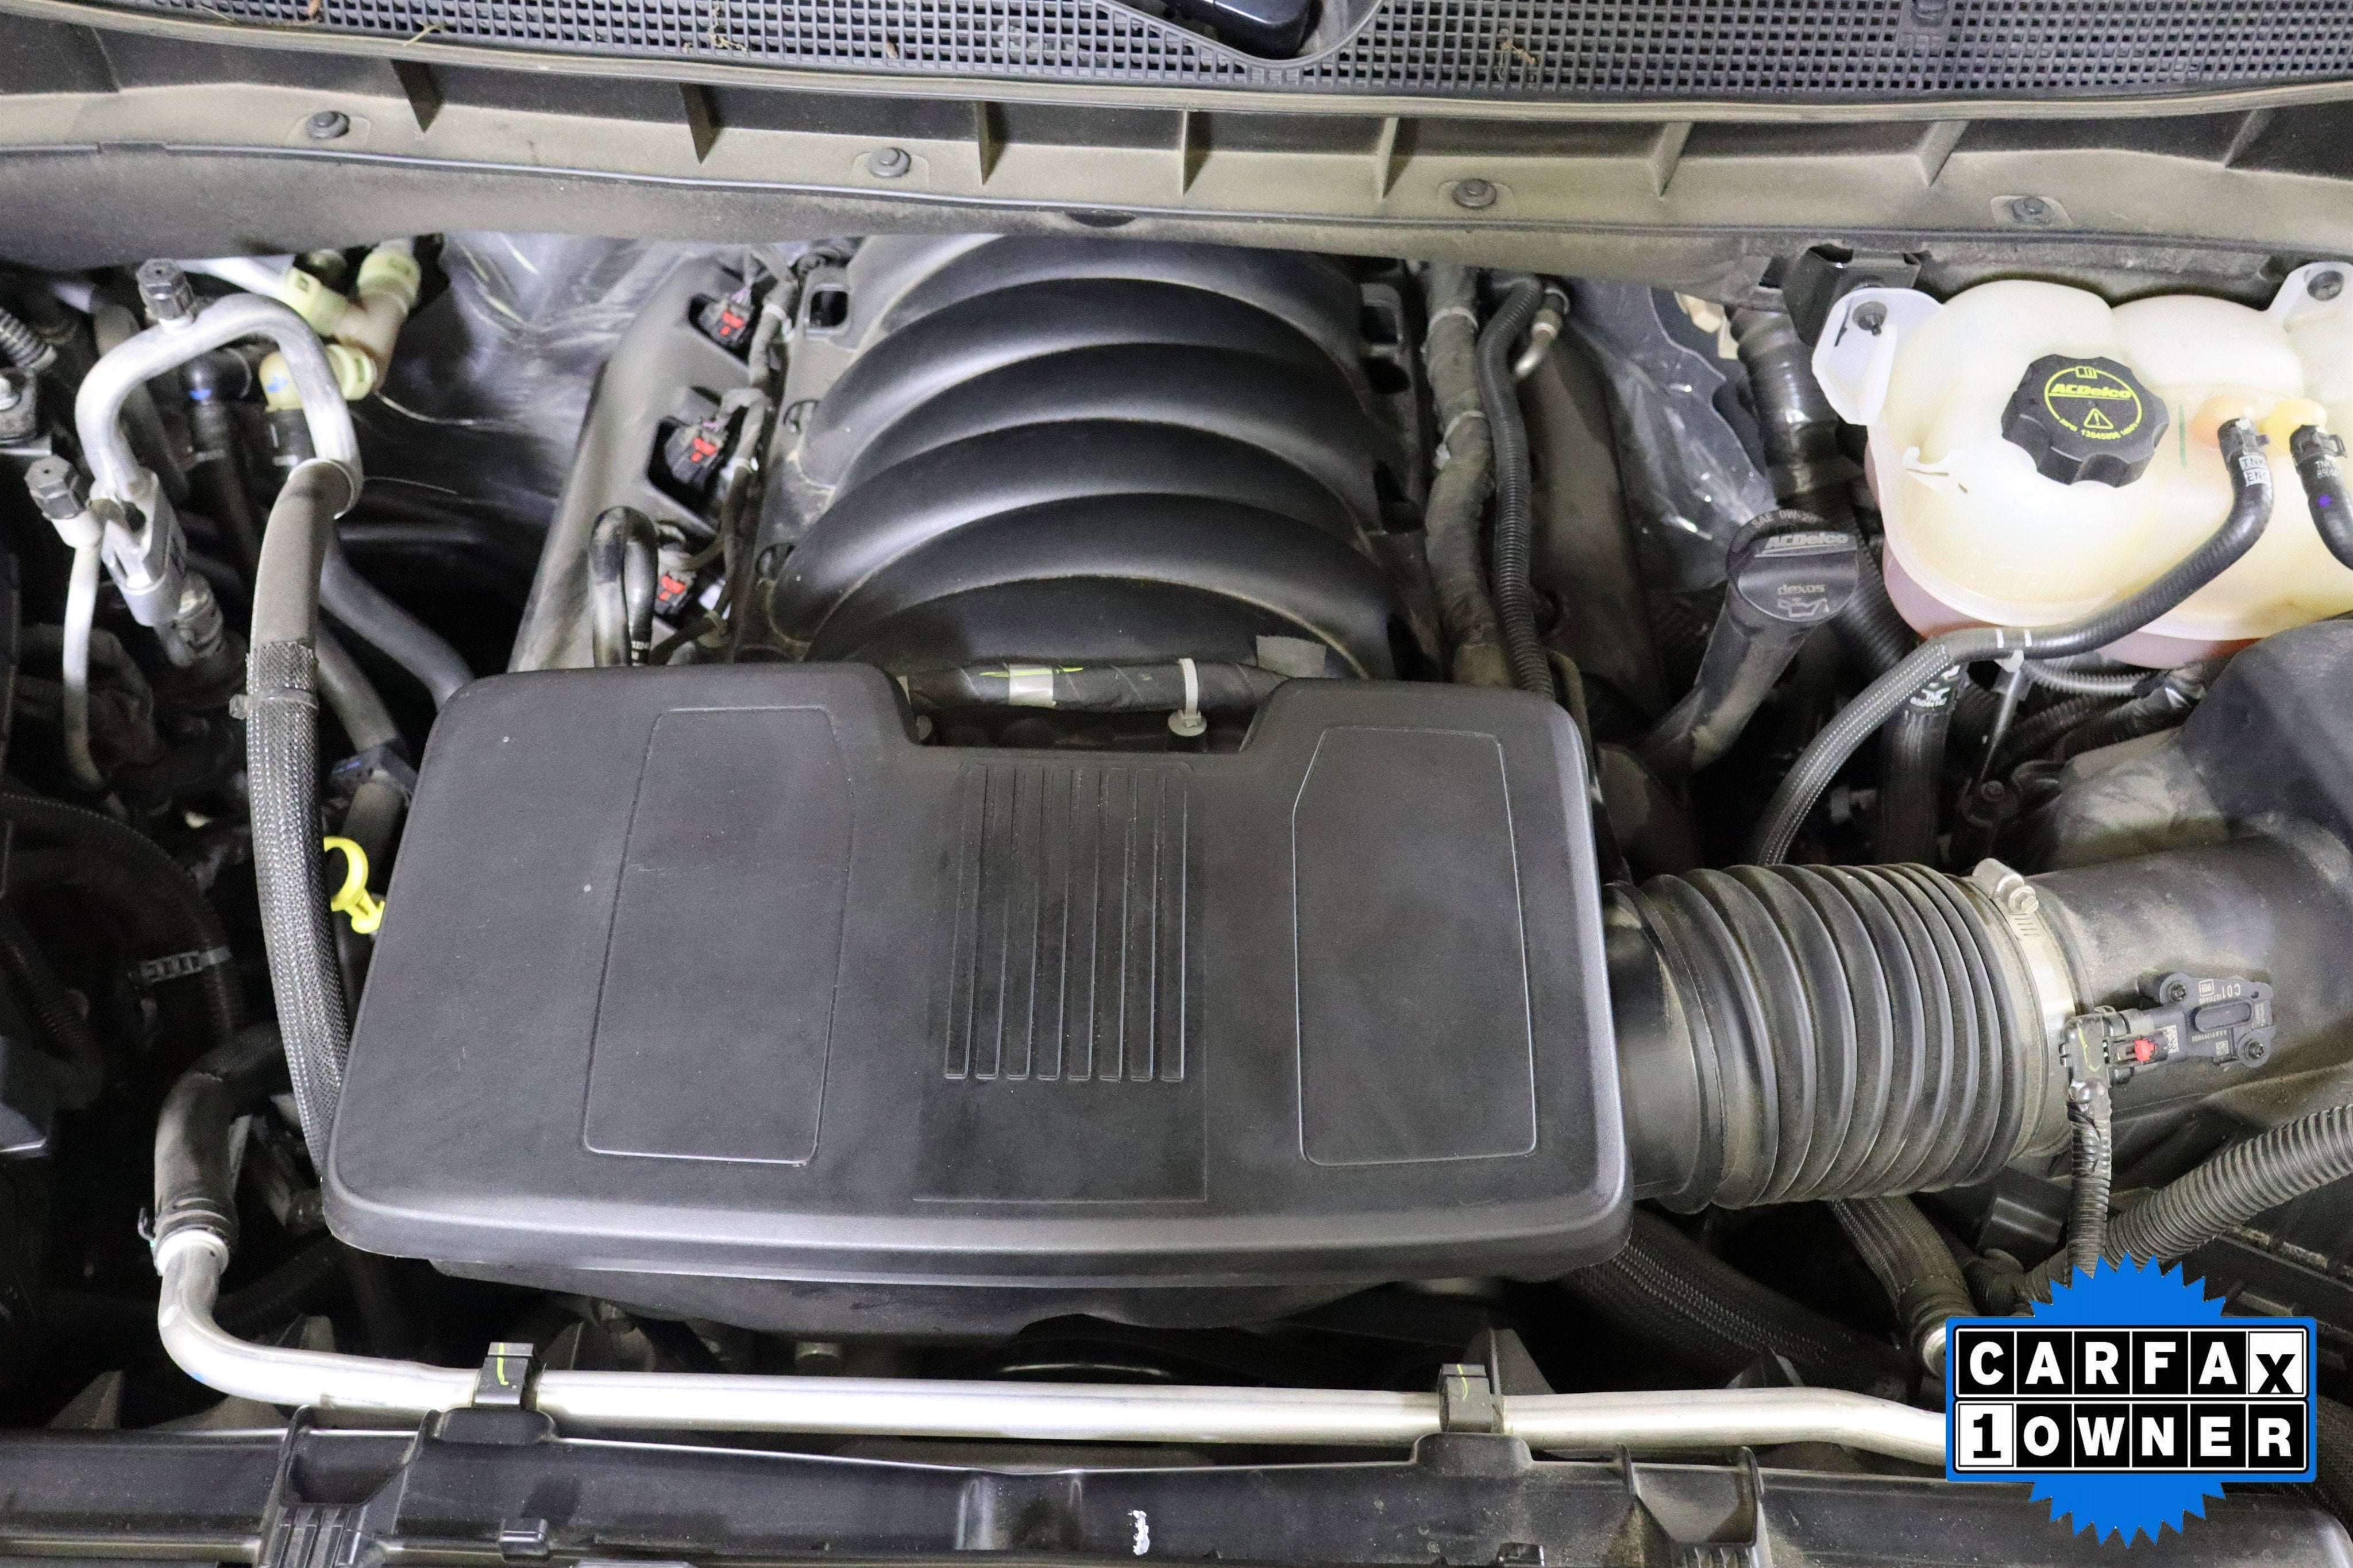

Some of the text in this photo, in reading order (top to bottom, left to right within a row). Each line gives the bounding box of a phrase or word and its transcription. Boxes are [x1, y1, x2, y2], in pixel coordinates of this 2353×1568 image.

[2051, 384, 2131, 398] ACDelco
[1752, 513, 1773, 528] SAE
[1764, 532, 1849, 549] ACDelco
[1777, 585, 1825, 594] dexos
